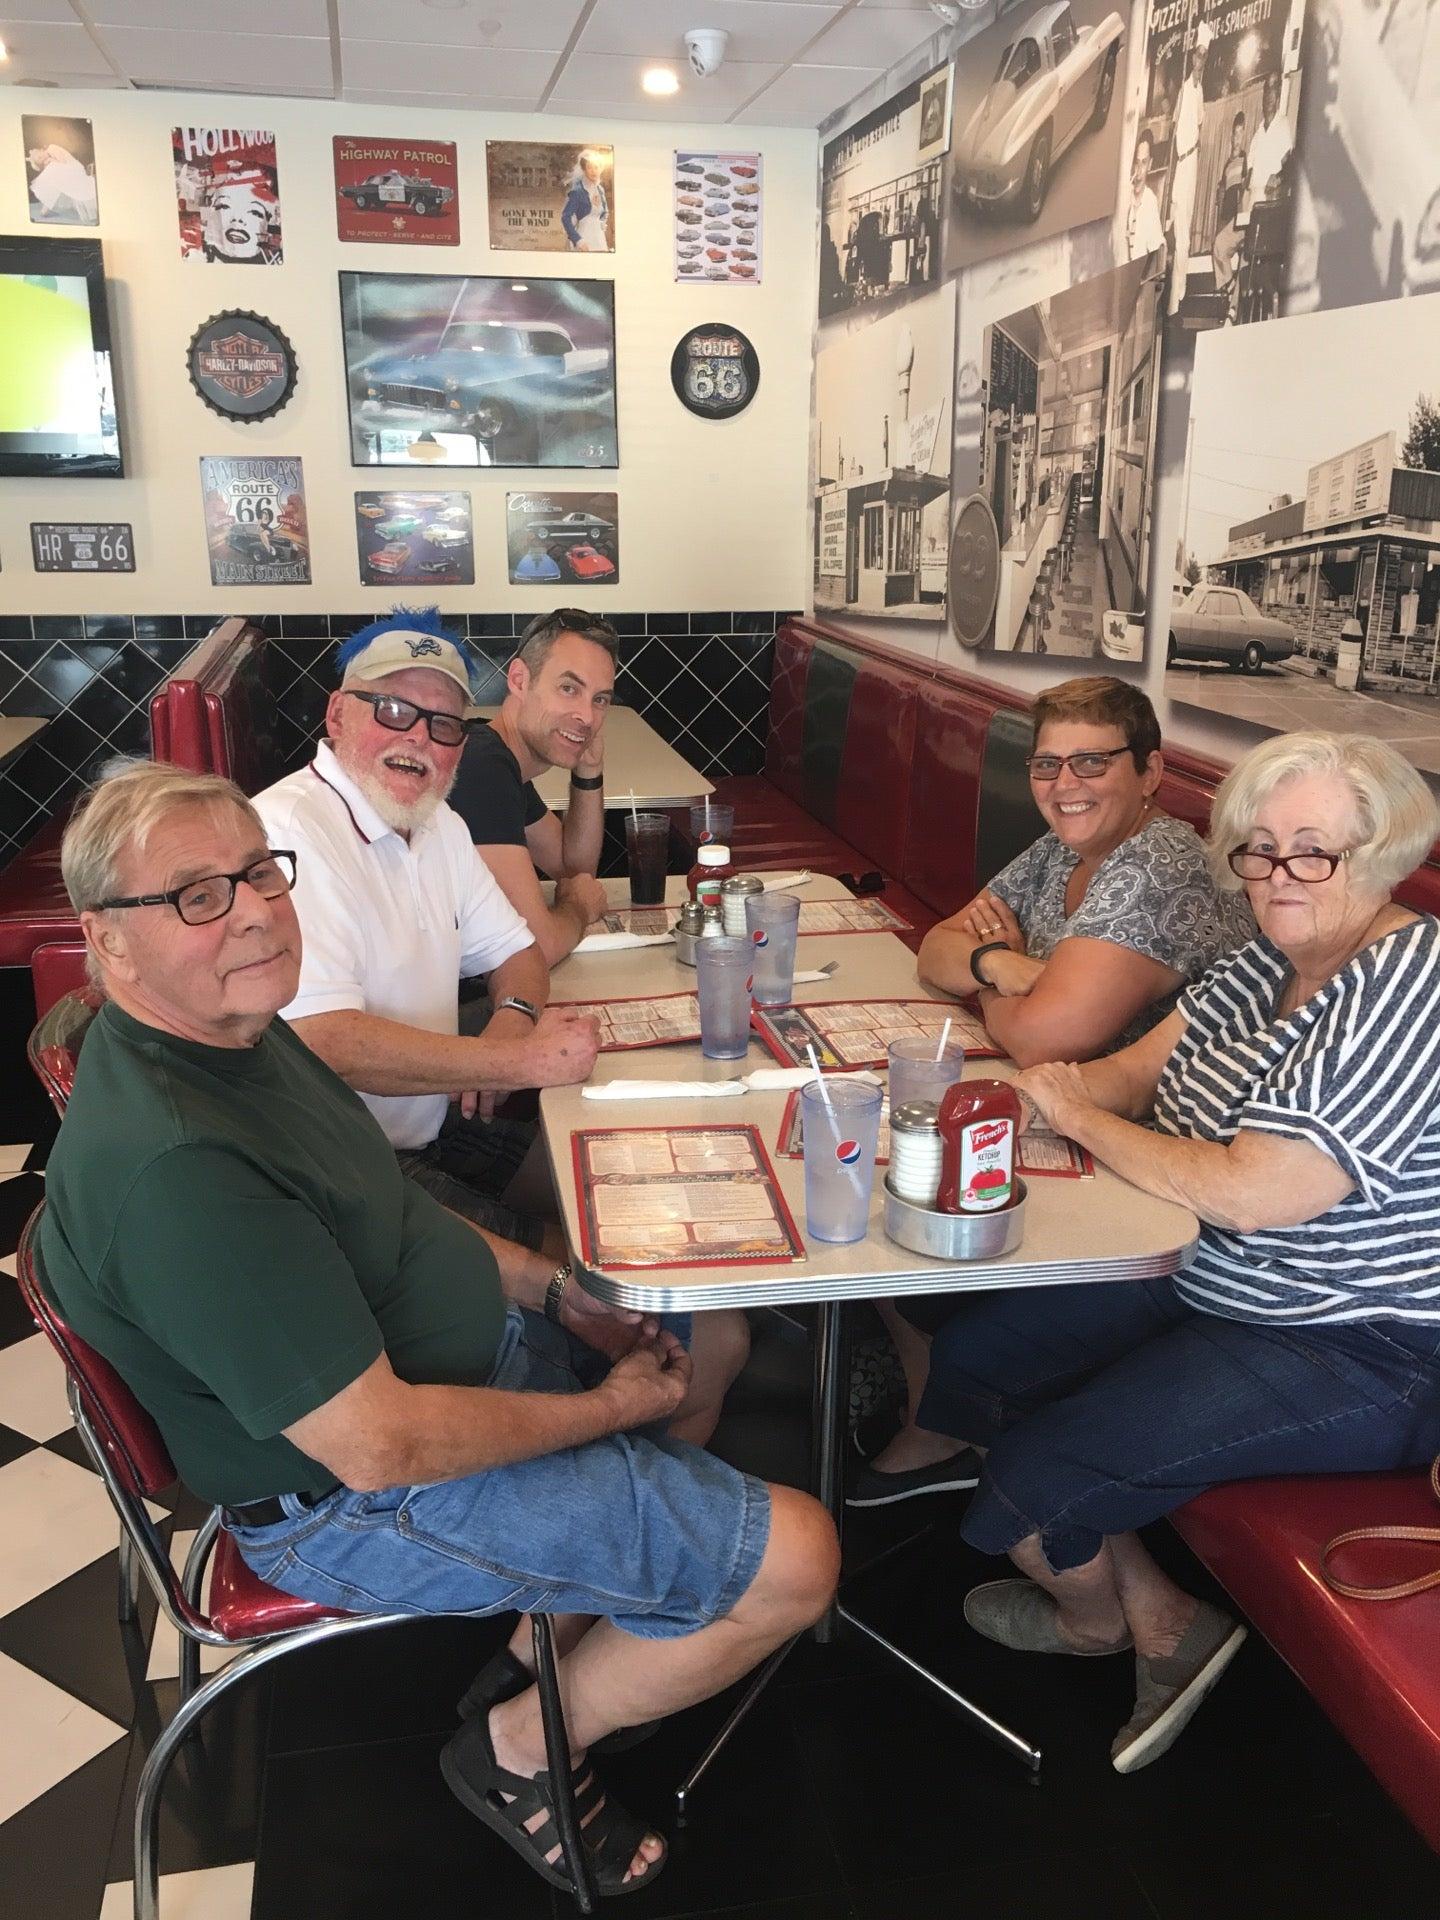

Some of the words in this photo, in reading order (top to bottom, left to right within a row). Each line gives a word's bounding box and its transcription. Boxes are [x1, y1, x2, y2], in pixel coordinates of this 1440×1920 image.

[1224, 0, 1272, 35] SPAGHETTI
[180, 127, 275, 161] HOLLYWOOD
[340, 150, 399, 160] HIGHWAY
[403, 150, 452, 165] PATROL
[502, 209, 528, 218] GONE
[530, 210, 554, 219] WITH
[508, 218, 523, 226] THE
[527, 219, 550, 227] WIND
[689, 340, 739, 356] ROUTE
[205, 358, 278, 372] HARLEY-DAVIDSON
[223, 376, 263, 391] CYCLES
[690, 363, 741, 399] 66
[206, 461, 298, 489] AMERICA'S
[232, 484, 274, 494] ROUTE
[235, 497, 274, 525] 66
[38, 534, 63, 561] HR
[100, 535, 128, 561] 66
[215, 559, 255, 580] MAIN
[255, 557, 307, 580] STREET
[975, 1124, 1007, 1144] French's
[978, 1150, 1001, 1161] KETCHUP
